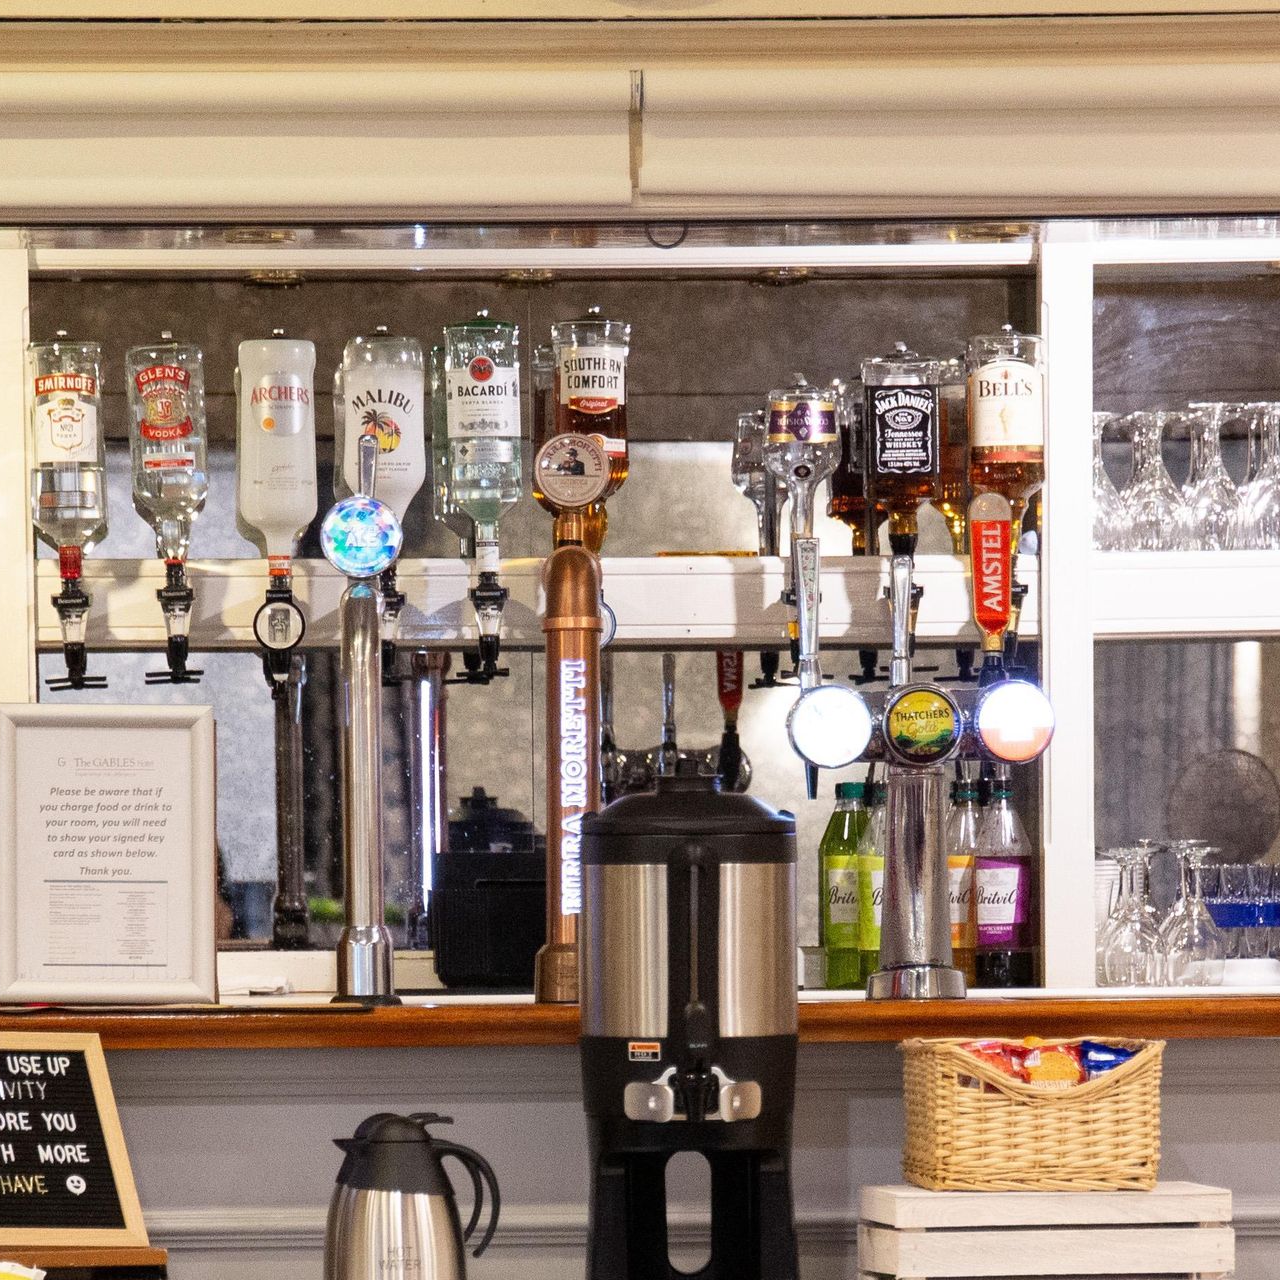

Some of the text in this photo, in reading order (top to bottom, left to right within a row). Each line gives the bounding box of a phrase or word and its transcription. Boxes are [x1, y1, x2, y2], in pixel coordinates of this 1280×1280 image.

[563, 356, 622, 374] SOUTHERN
[139, 367, 186, 383] GLEN'S
[567, 375, 619, 390] COMFORT
[37, 376, 95, 391] SMIRNOFF
[978, 377, 1033, 398] BELL'S
[250, 384, 309, 406] ARCHERS
[351, 388, 415, 416] MALIBU
[875, 391, 934, 415] JACK DANIEL'S
[148, 429, 183, 438] VODKA
[884, 428, 924, 439] Tennessee
[885, 441, 924, 449] WHISKEY
[982, 522, 1003, 612] AMSTEL
[894, 707, 950, 721] THATCHERS
[560, 658, 587, 807] MORETTI
[906, 721, 939, 738] Gold
[74, 757, 92, 768] The
[92, 757, 136, 768] GABLES
[50, 787, 163, 798] Please be aware that if
[40, 804, 58, 814] you
[60, 802, 93, 814] charge
[95, 802, 118, 814] food
[134, 802, 159, 811] drink
[162, 803, 172, 811] to
[45, 818, 167, 829] your room, you will need
[47, 833, 165, 844] to show your signed key
[53, 849, 158, 858] card as shown below.
[79, 866, 132, 877] Thank you.
[6, 1055, 45, 1076] USE
[47, 1056, 71, 1077] UP
[41, 1112, 77, 1132] YOU
[37, 1144, 90, 1164] MORE
[0, 1175, 49, 1196] HAVE
